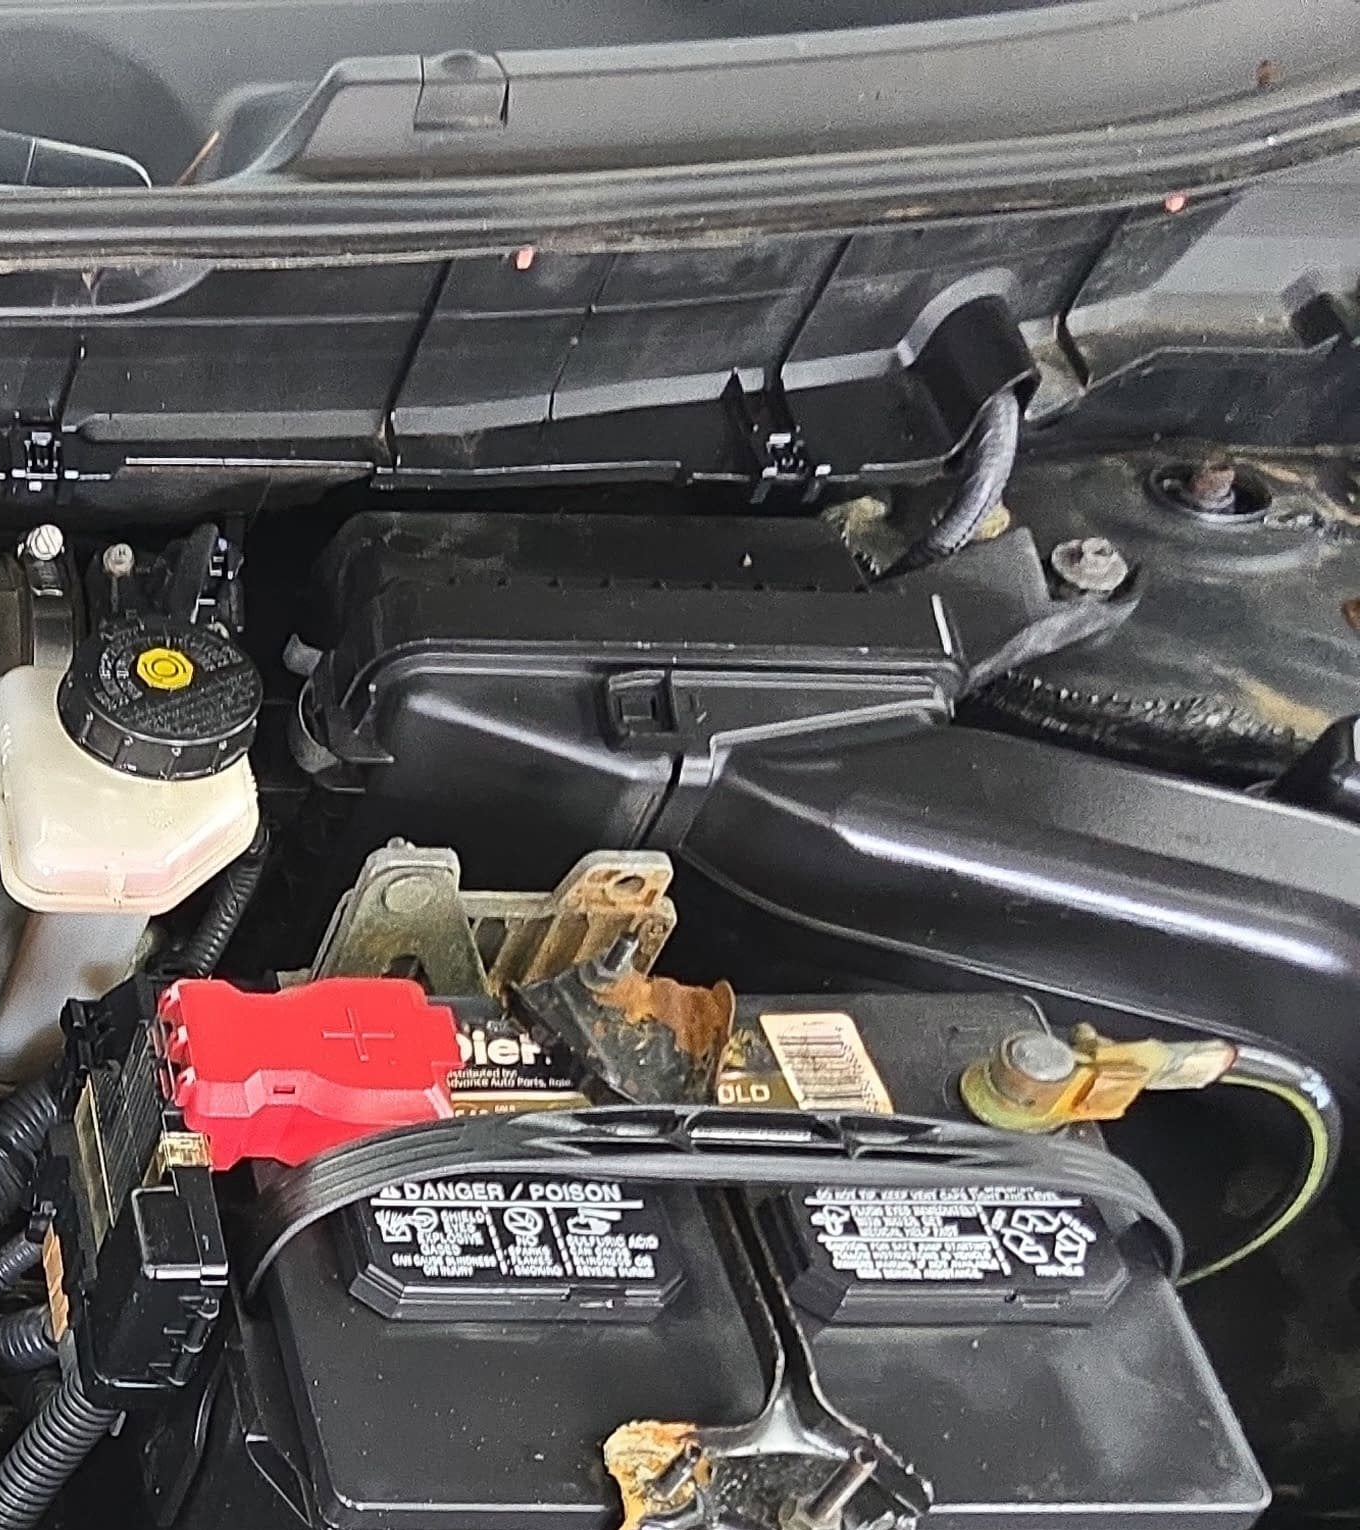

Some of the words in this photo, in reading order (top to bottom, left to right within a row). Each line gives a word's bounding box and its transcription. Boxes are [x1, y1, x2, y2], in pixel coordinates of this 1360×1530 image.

[716, 1083, 771, 1105] OLD
[402, 1182, 505, 1201] DANGER
[529, 1182, 623, 1202] POISON
